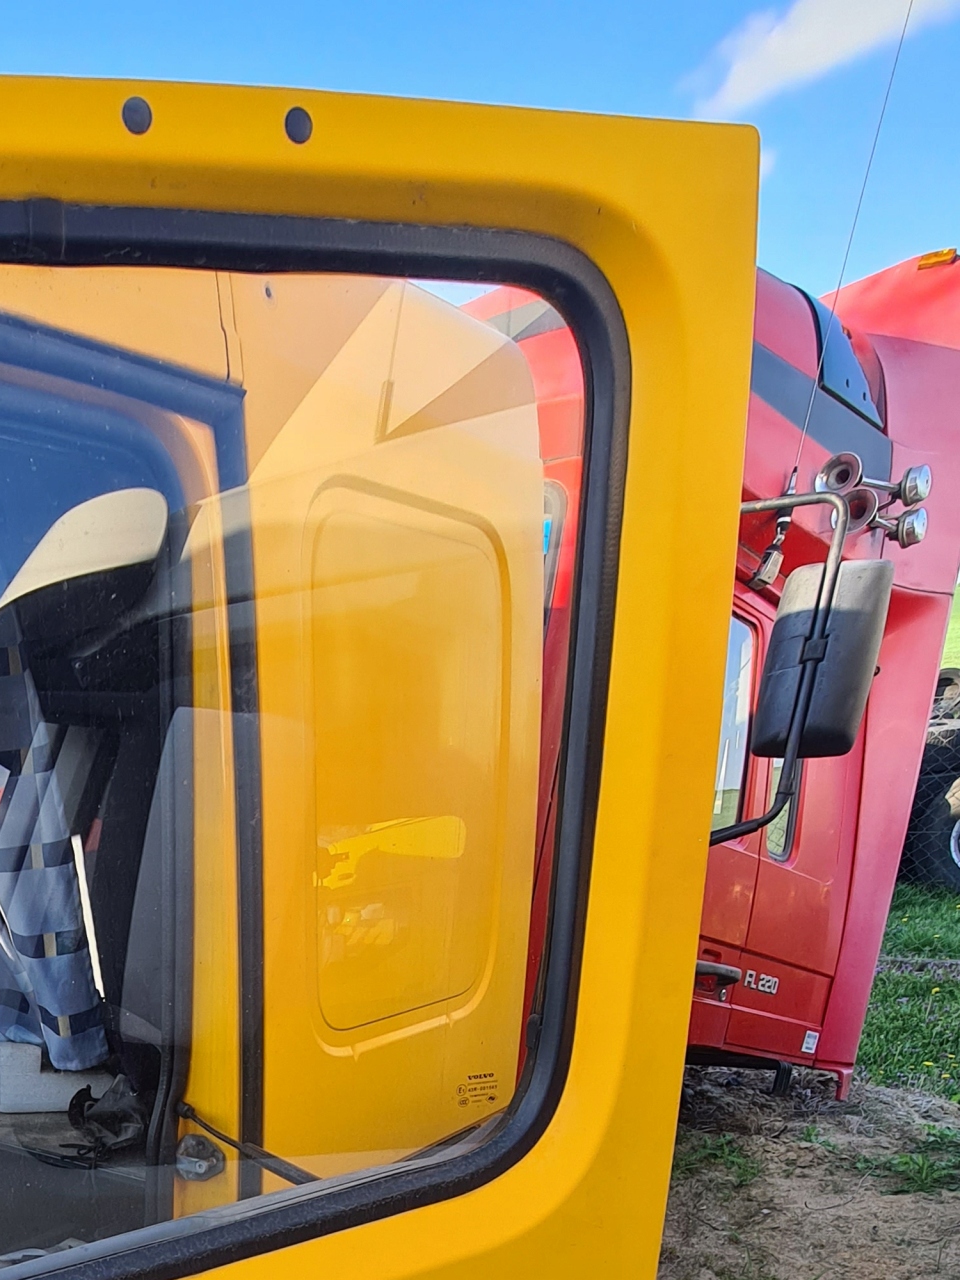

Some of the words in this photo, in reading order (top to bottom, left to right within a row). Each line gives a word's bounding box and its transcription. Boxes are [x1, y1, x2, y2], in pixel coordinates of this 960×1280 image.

[744, 969, 757, 989] FL
[758, 973, 779, 995] 220
[468, 1072, 494, 1080] VOLVO
